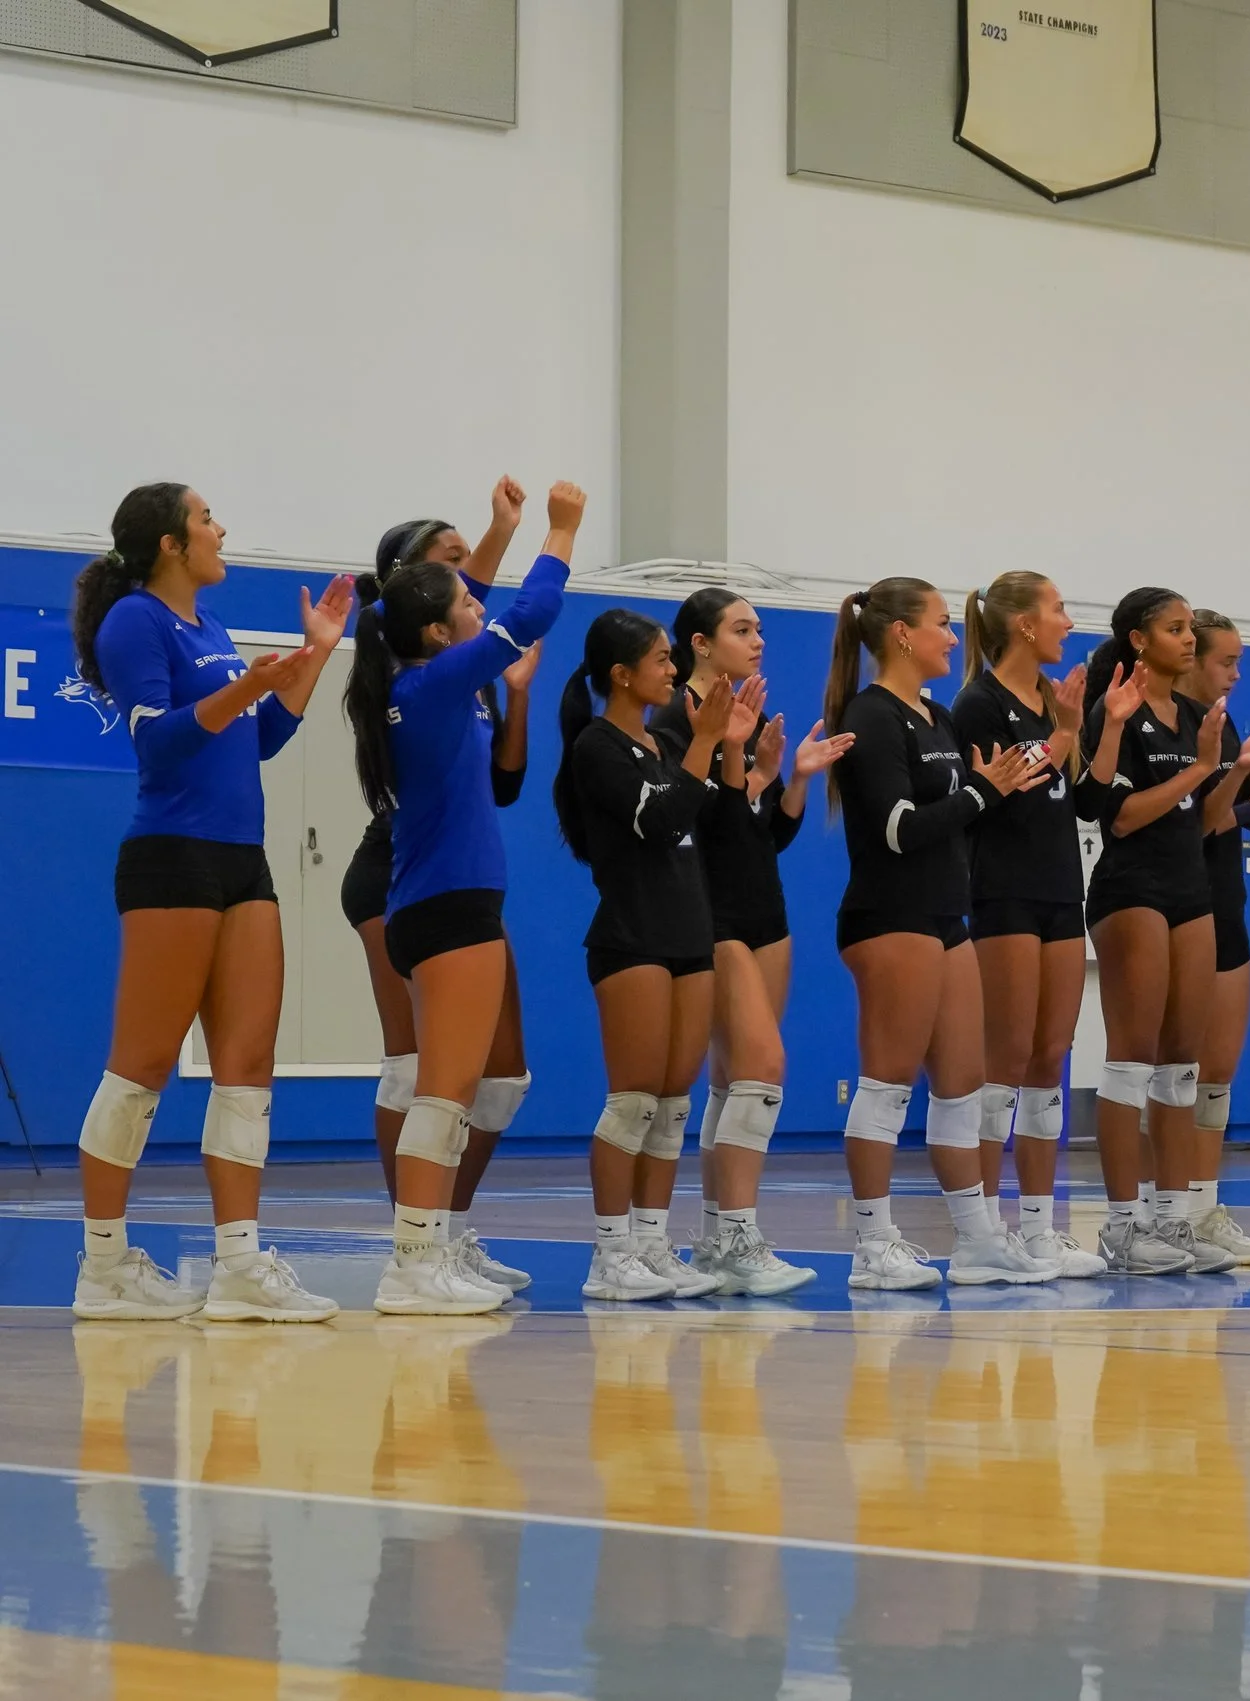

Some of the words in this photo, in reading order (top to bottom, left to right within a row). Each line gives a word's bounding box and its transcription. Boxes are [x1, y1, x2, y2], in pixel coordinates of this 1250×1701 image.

[1019, 10, 1043, 24] STATE
[980, 22, 1007, 42] 2023
[5, 648, 36, 719] E
[1148, 753, 1179, 762] SANTA
